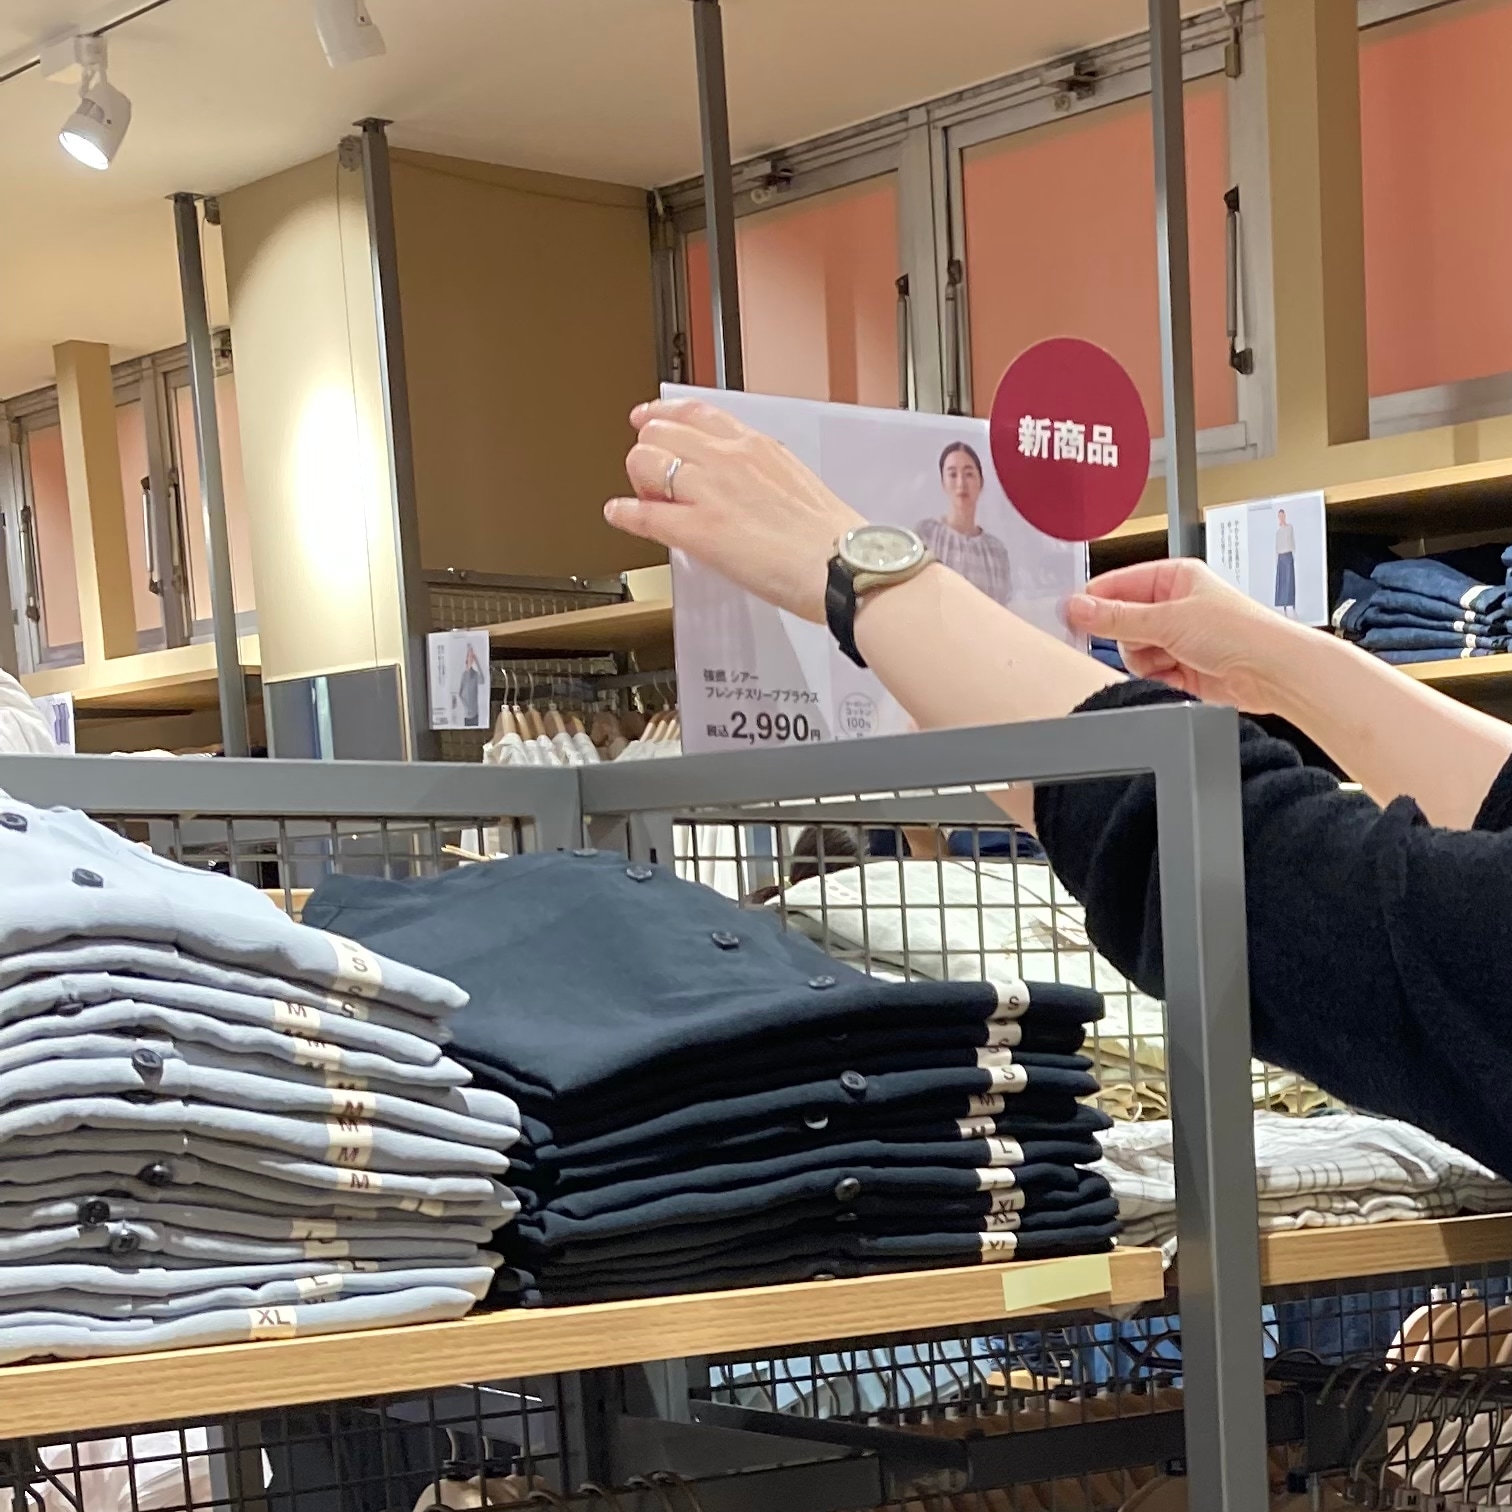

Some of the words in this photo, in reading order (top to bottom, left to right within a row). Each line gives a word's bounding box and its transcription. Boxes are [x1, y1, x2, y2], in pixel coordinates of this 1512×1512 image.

[1017, 414, 1120, 468] 新商品
[731, 671, 760, 683] シアー
[705, 686, 819, 704] フレンチスリーブブラウス
[847, 717, 871, 729] 100%
[352, 956, 368, 973] S
[284, 1002, 307, 1018] M
[1008, 995, 1020, 1011] S
[1001, 1067, 1015, 1081] S
[344, 1100, 364, 1117] M
[337, 1146, 359, 1162] M
[999, 1139, 1013, 1154] L
[350, 1172, 370, 1189] M
[256, 1308, 291, 1326] XL
[1407, 1494, 1417, 1506] M
